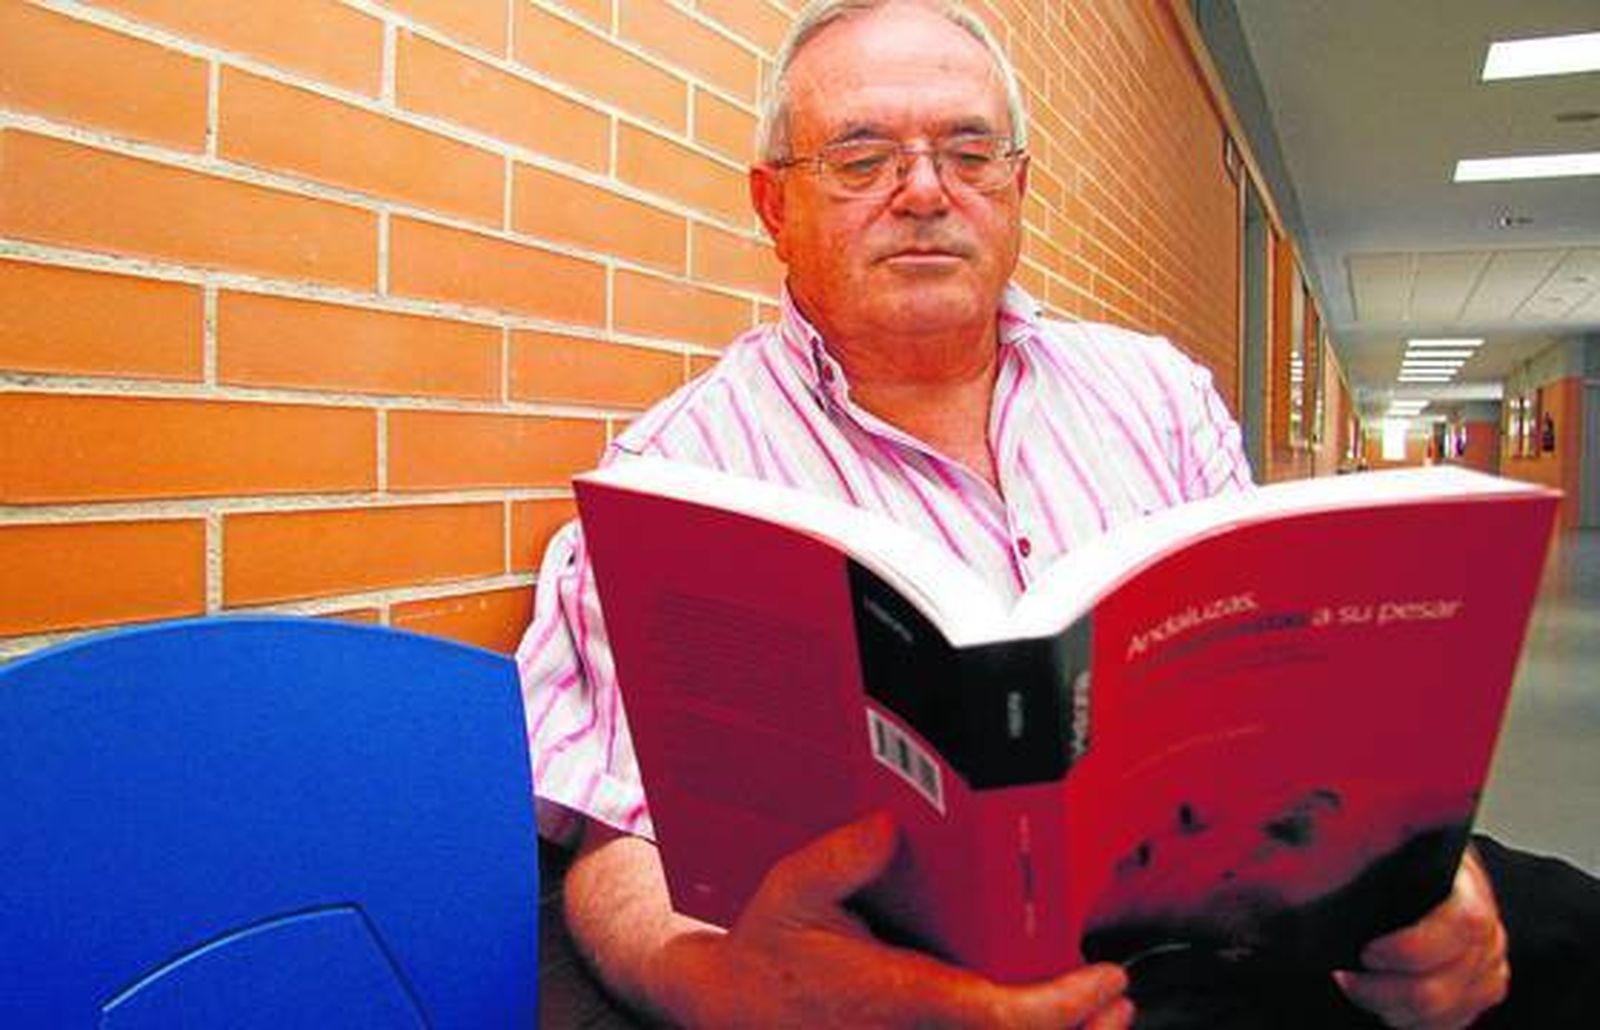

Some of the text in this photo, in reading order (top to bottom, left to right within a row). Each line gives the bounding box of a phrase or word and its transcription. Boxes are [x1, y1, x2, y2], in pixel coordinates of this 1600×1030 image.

[1311, 600, 1461, 626] a su pesar
